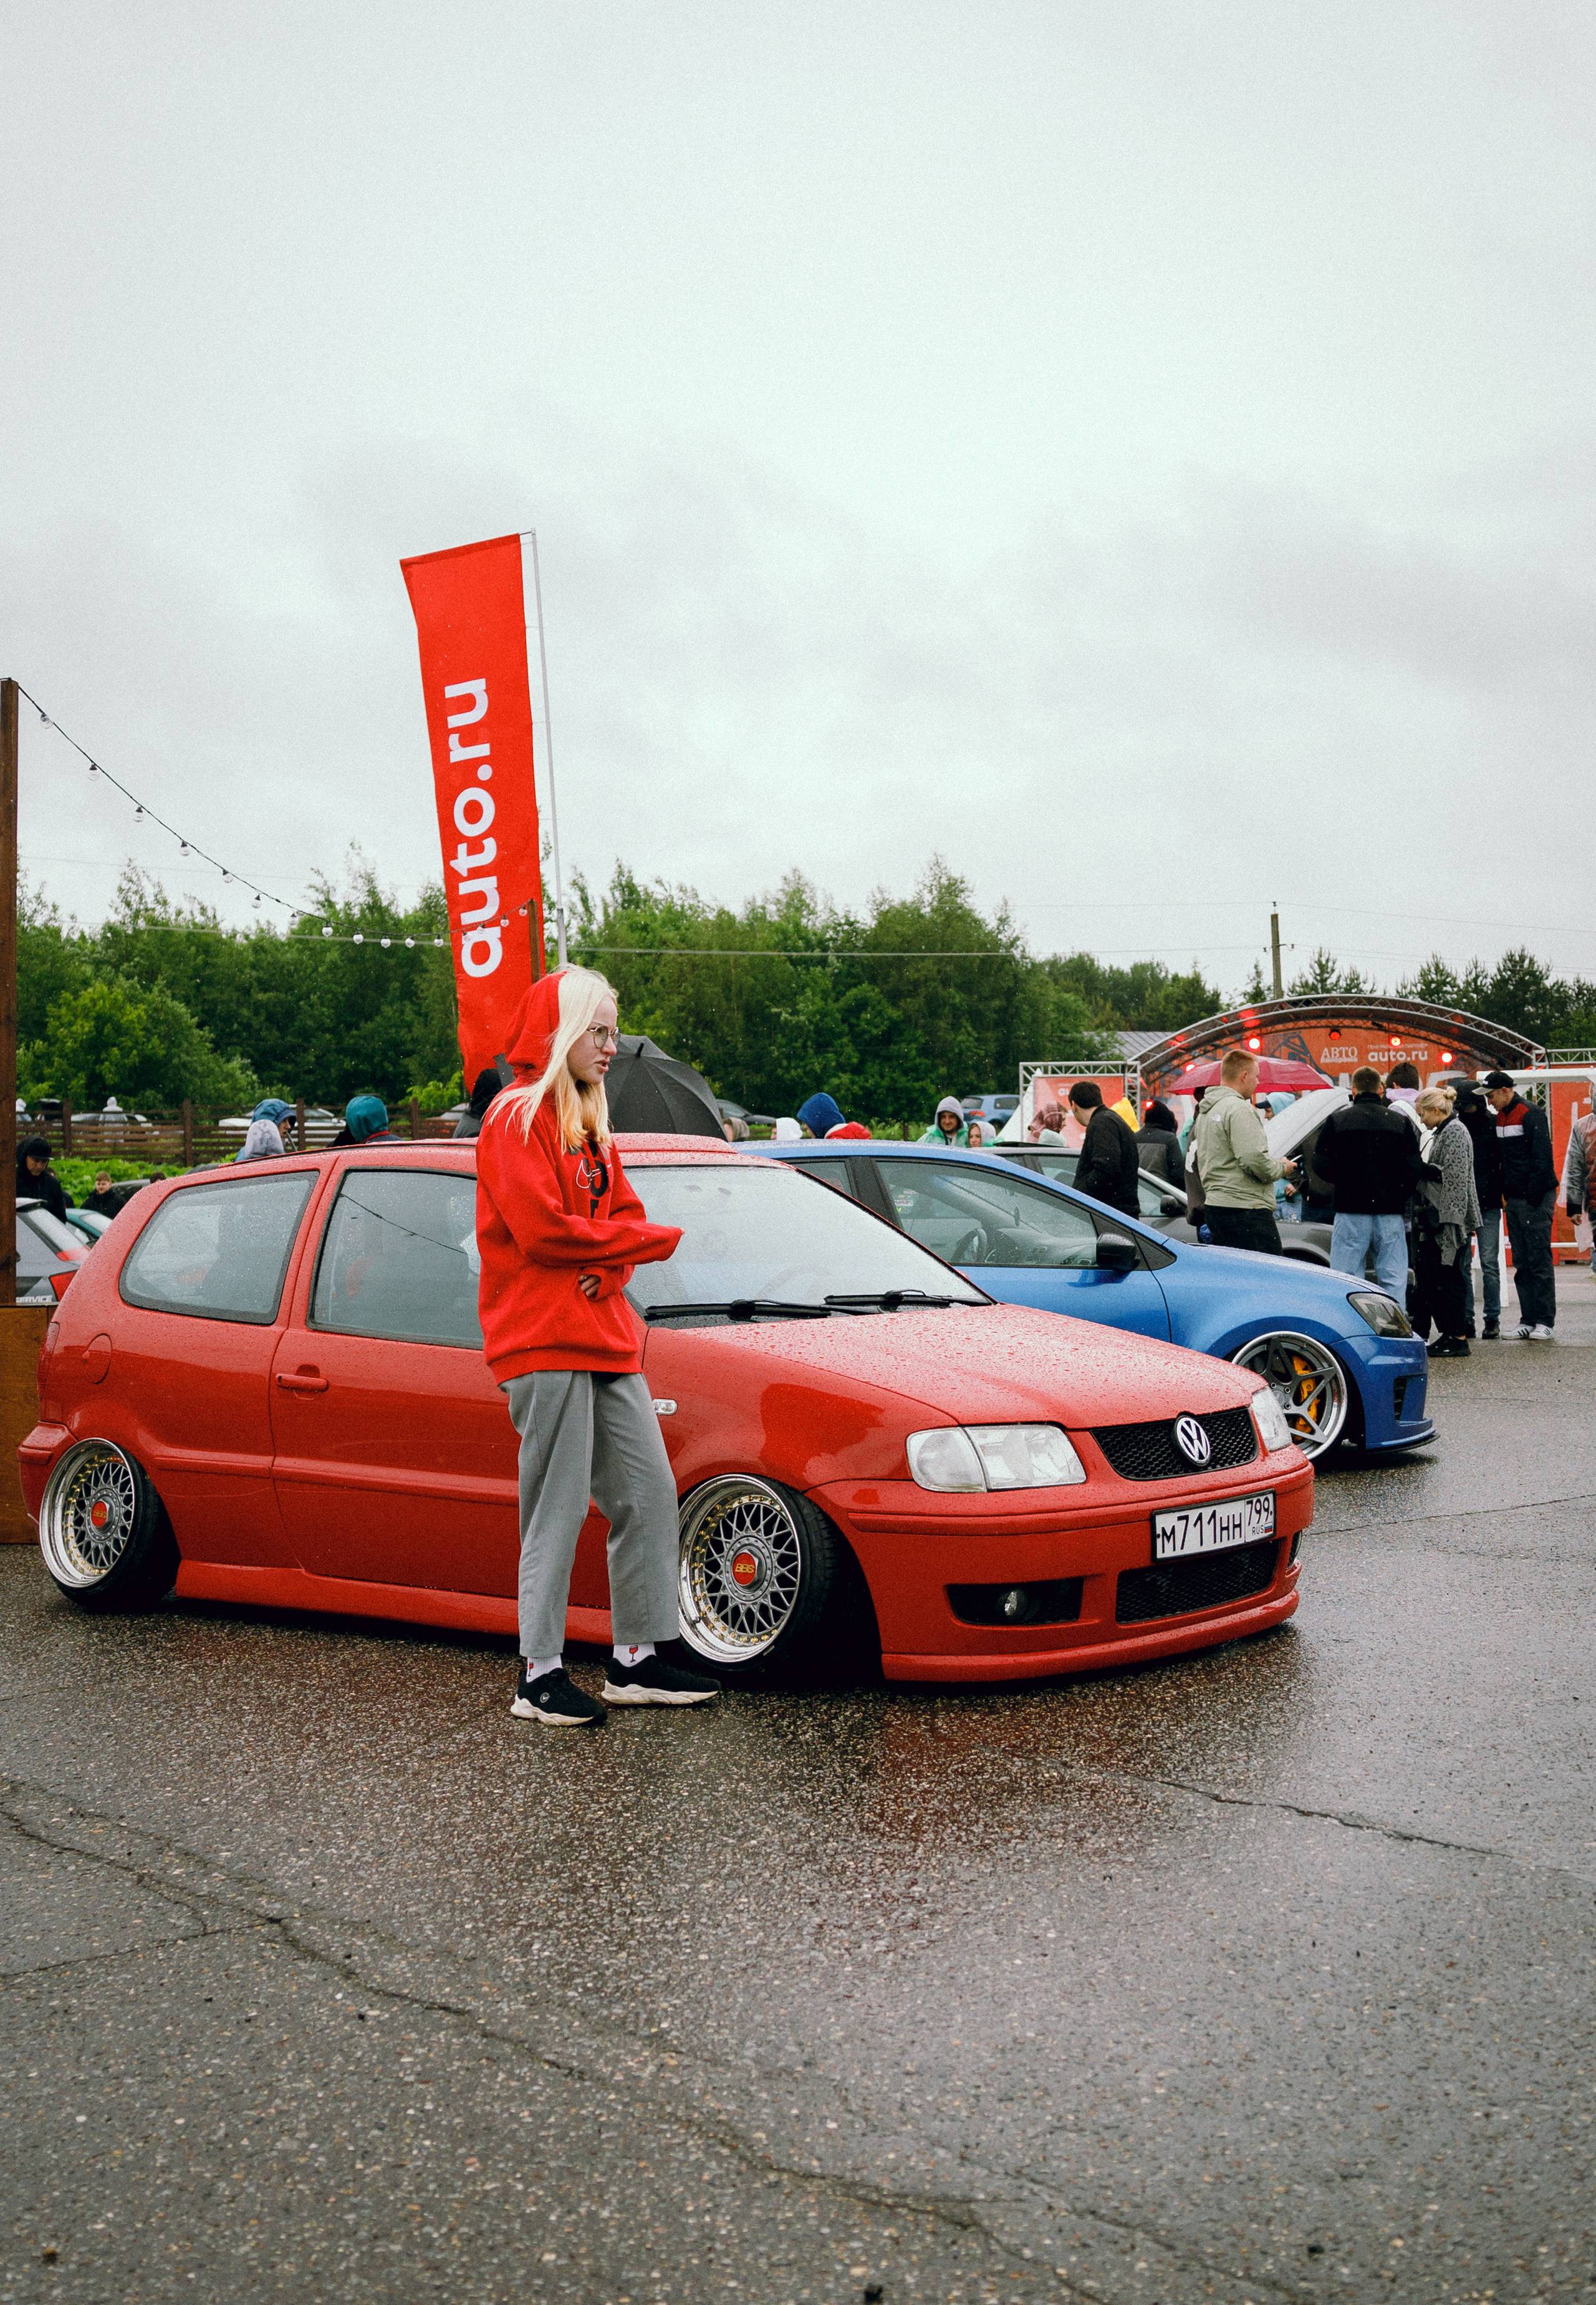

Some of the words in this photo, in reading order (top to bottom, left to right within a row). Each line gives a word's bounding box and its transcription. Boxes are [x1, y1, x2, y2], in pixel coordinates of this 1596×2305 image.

[445, 678, 502, 978] auto.ru
[1320, 1047, 1358, 1059] АВТО
[1368, 1051, 1428, 1062] auto.ru
[1246, 1496, 1270, 1527] 799
[1252, 1525, 1264, 1536] RUS
[735, 1563, 755, 1573] BBS
